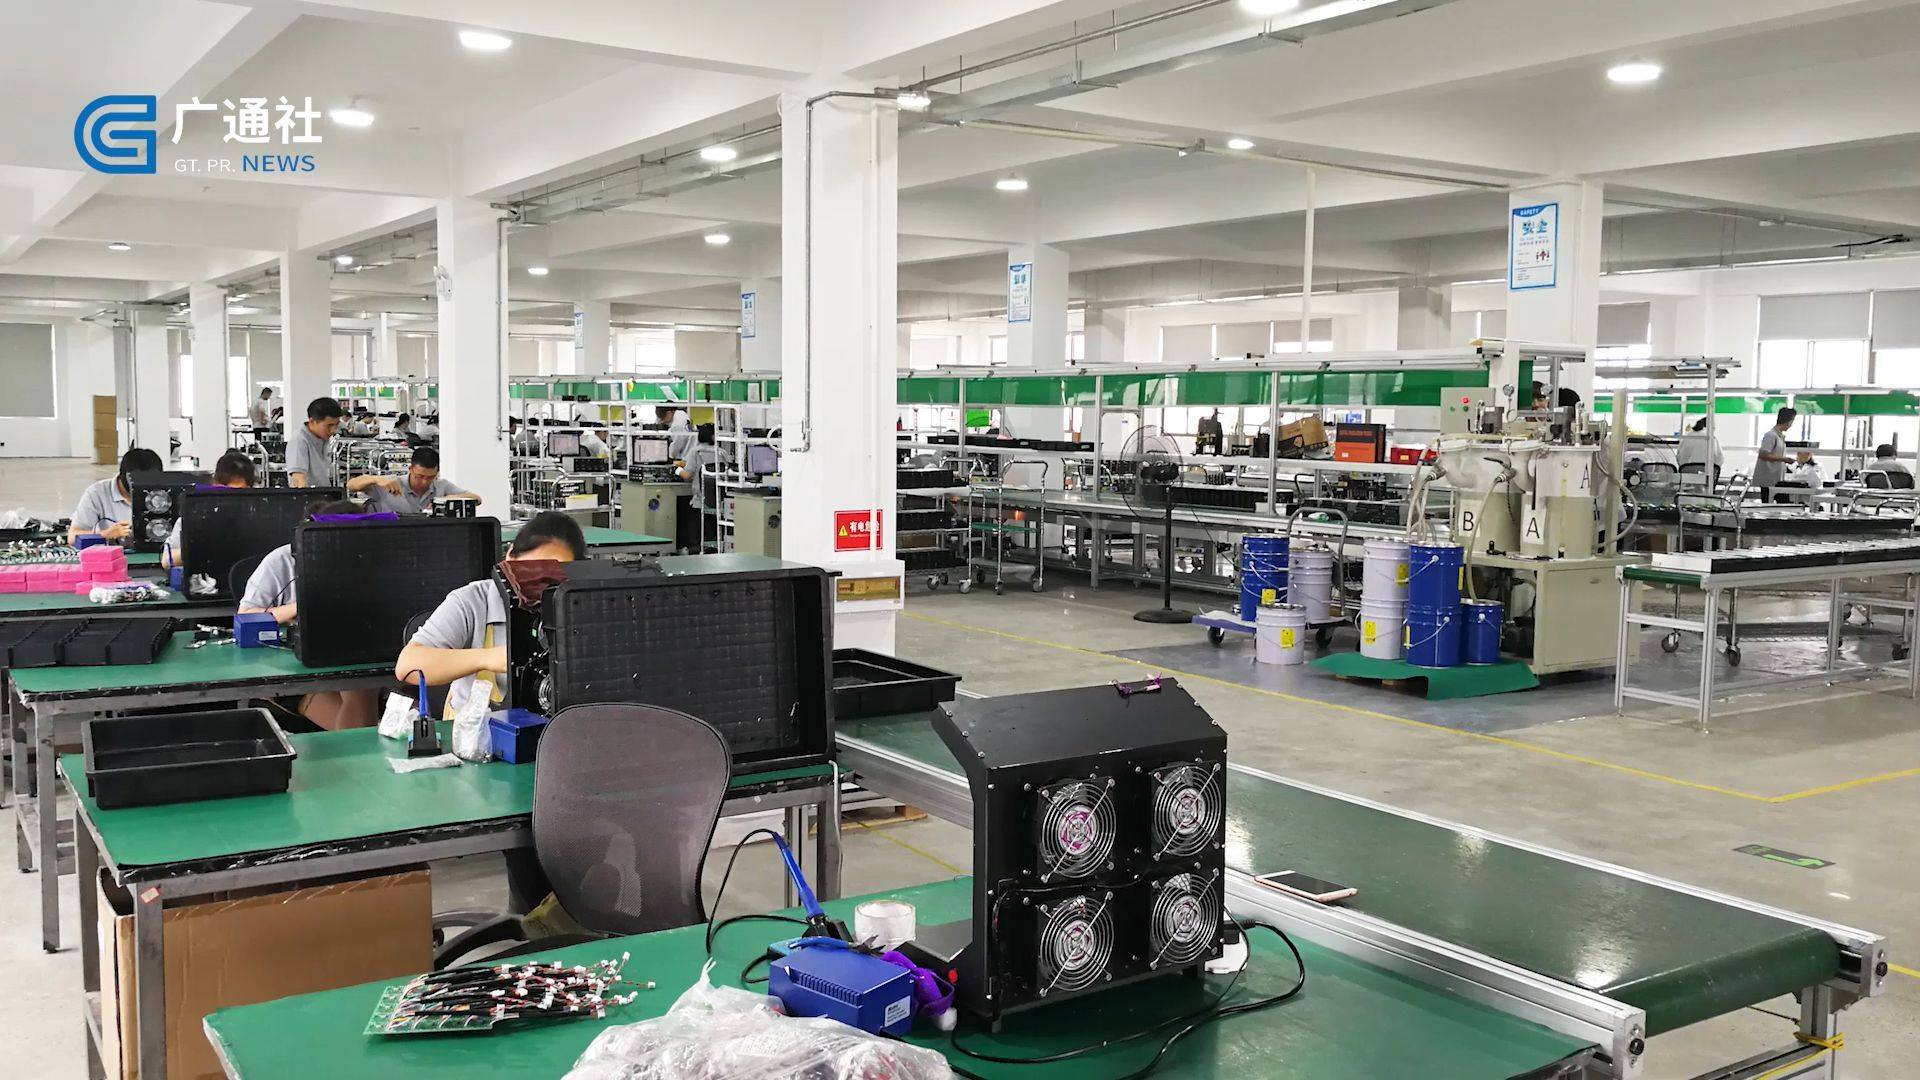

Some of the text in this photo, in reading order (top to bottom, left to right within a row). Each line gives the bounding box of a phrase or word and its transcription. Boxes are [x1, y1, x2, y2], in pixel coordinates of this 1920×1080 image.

[1520, 208, 1539, 216] SAFETY
[1580, 463, 1590, 489] A
[1462, 511, 1475, 532] B
[1525, 516, 1541, 539] A
